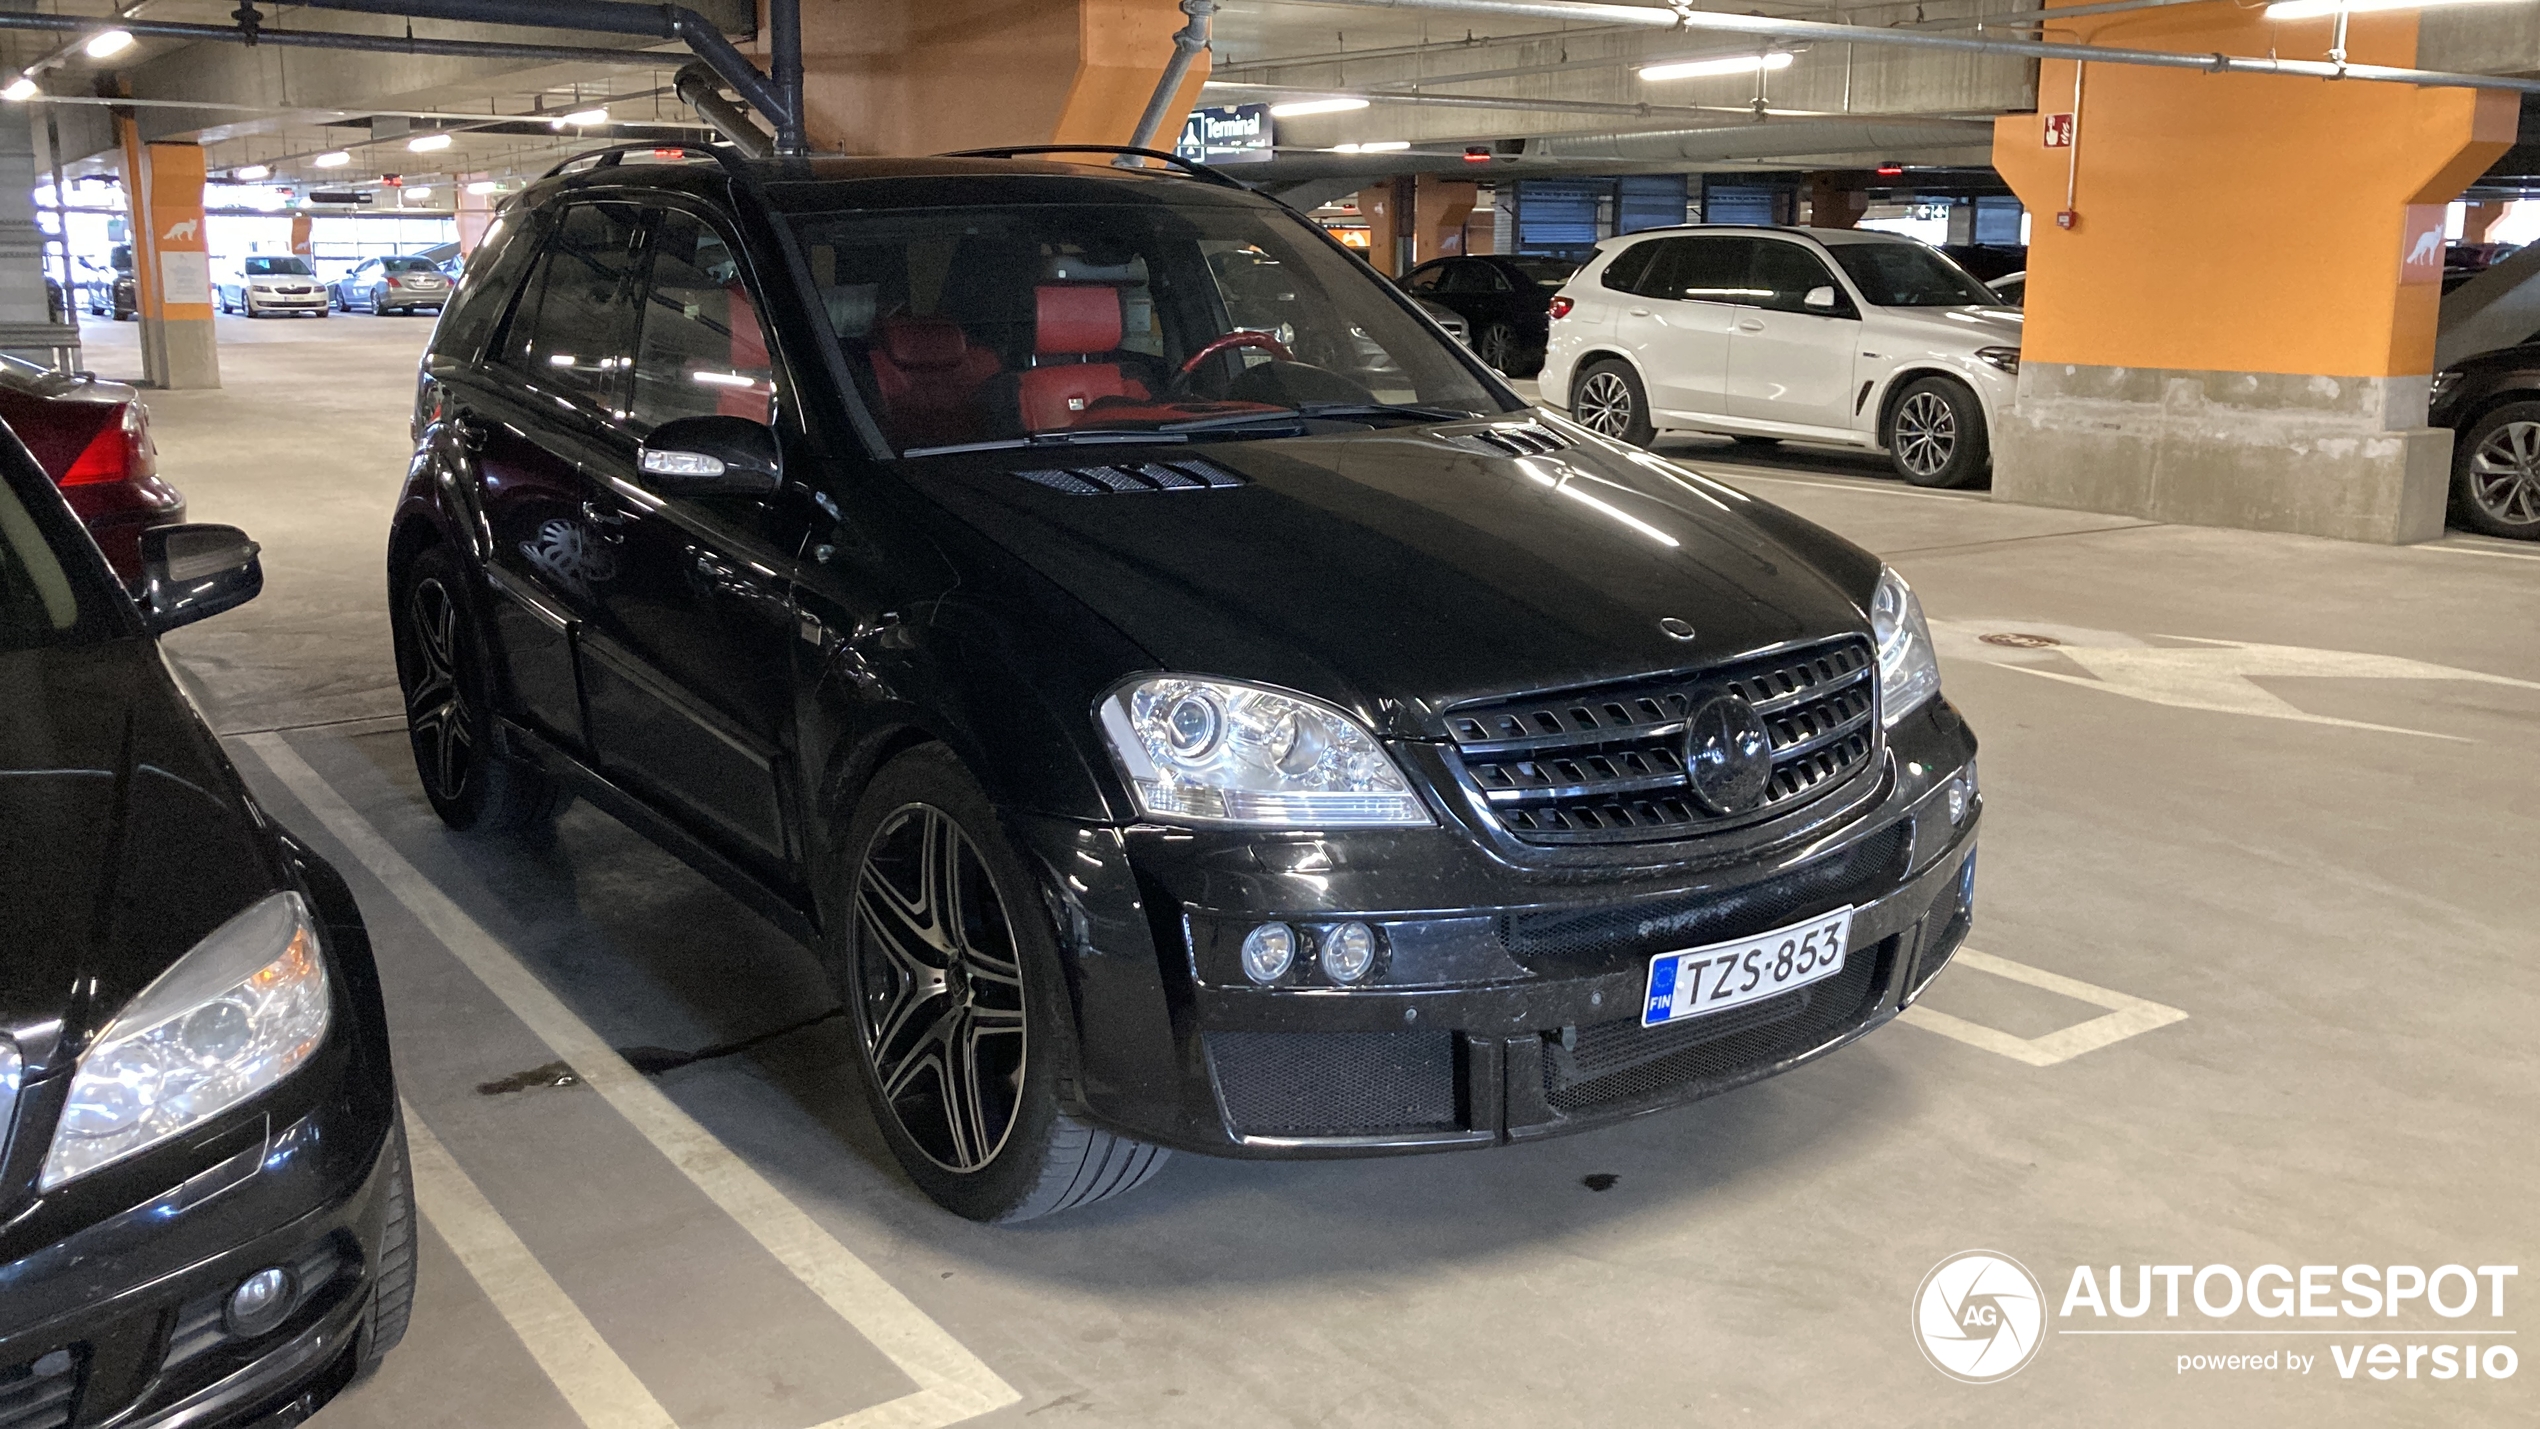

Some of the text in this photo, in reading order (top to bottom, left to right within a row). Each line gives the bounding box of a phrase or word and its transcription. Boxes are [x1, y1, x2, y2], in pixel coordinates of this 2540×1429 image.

[1205, 112, 1260, 139] Terminal
[1687, 921, 1842, 1006] TZS-853
[1649, 993, 1672, 1011] FIN
